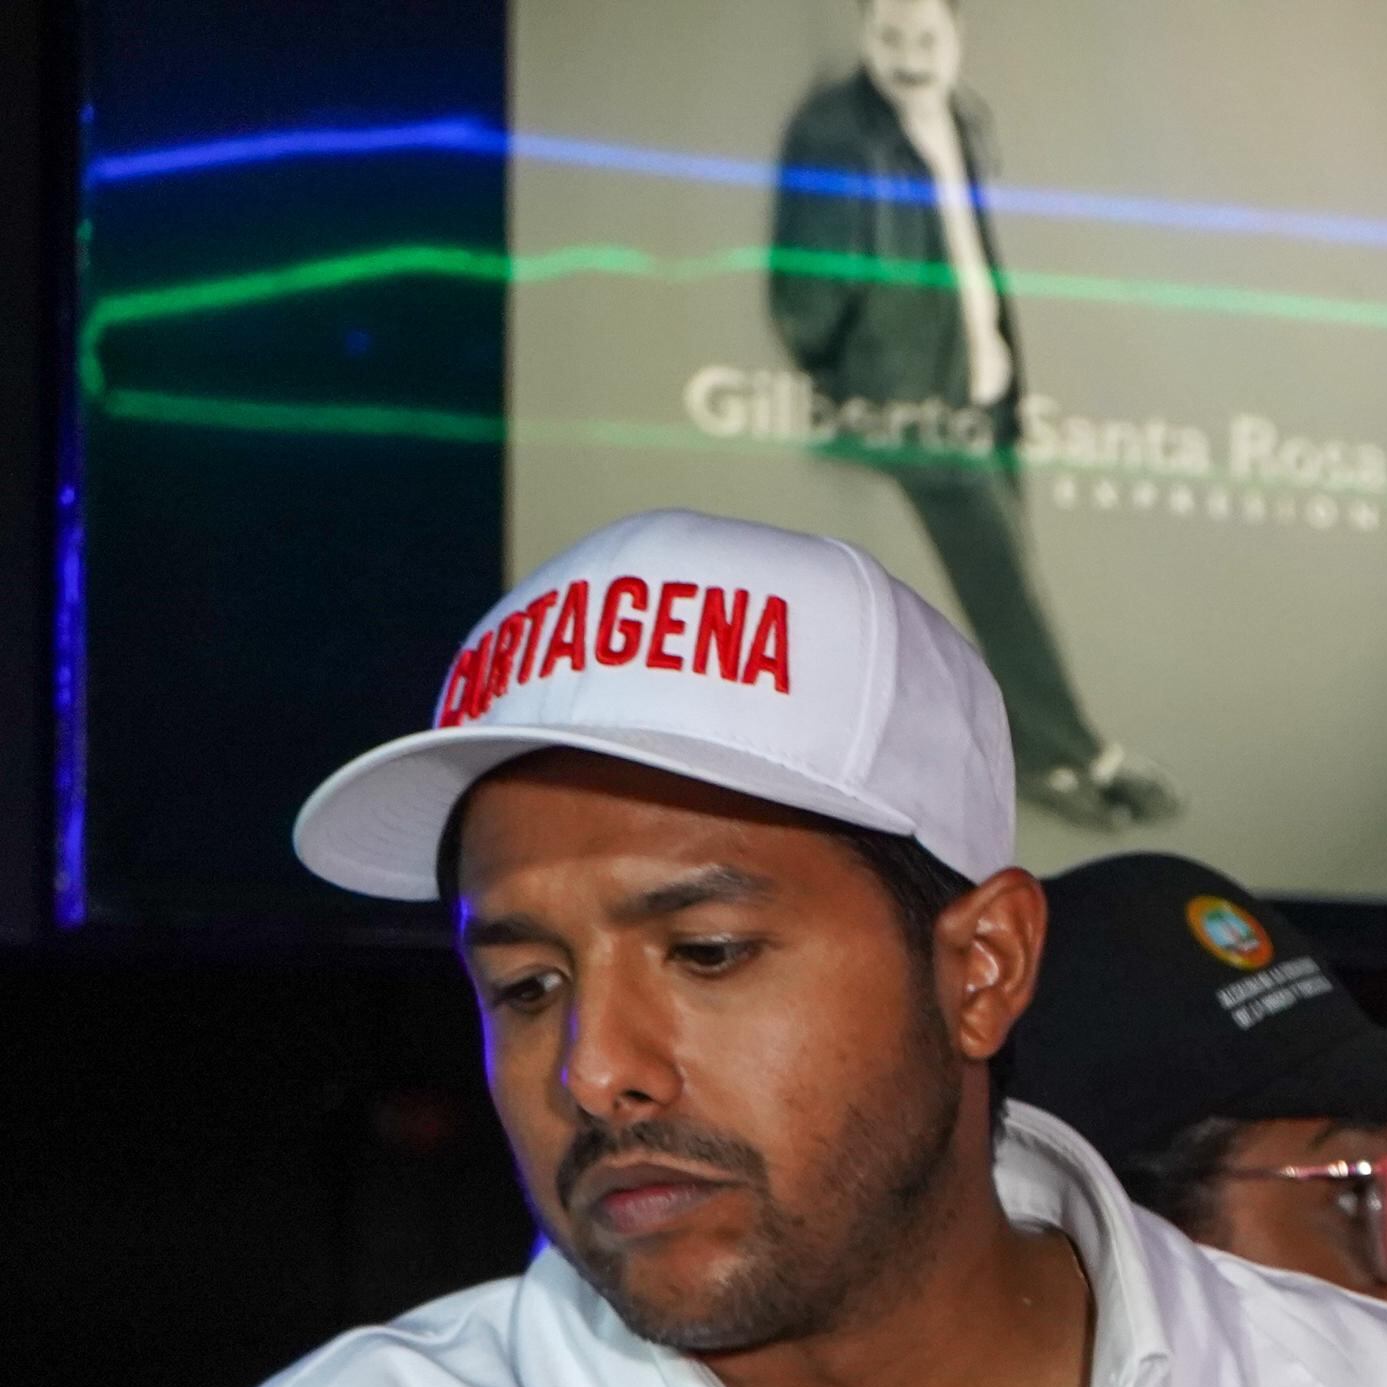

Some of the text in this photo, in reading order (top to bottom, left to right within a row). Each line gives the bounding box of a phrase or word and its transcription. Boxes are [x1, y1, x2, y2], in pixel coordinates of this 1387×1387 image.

[682, 366, 1387, 494] Gilberto Santa Rosa
